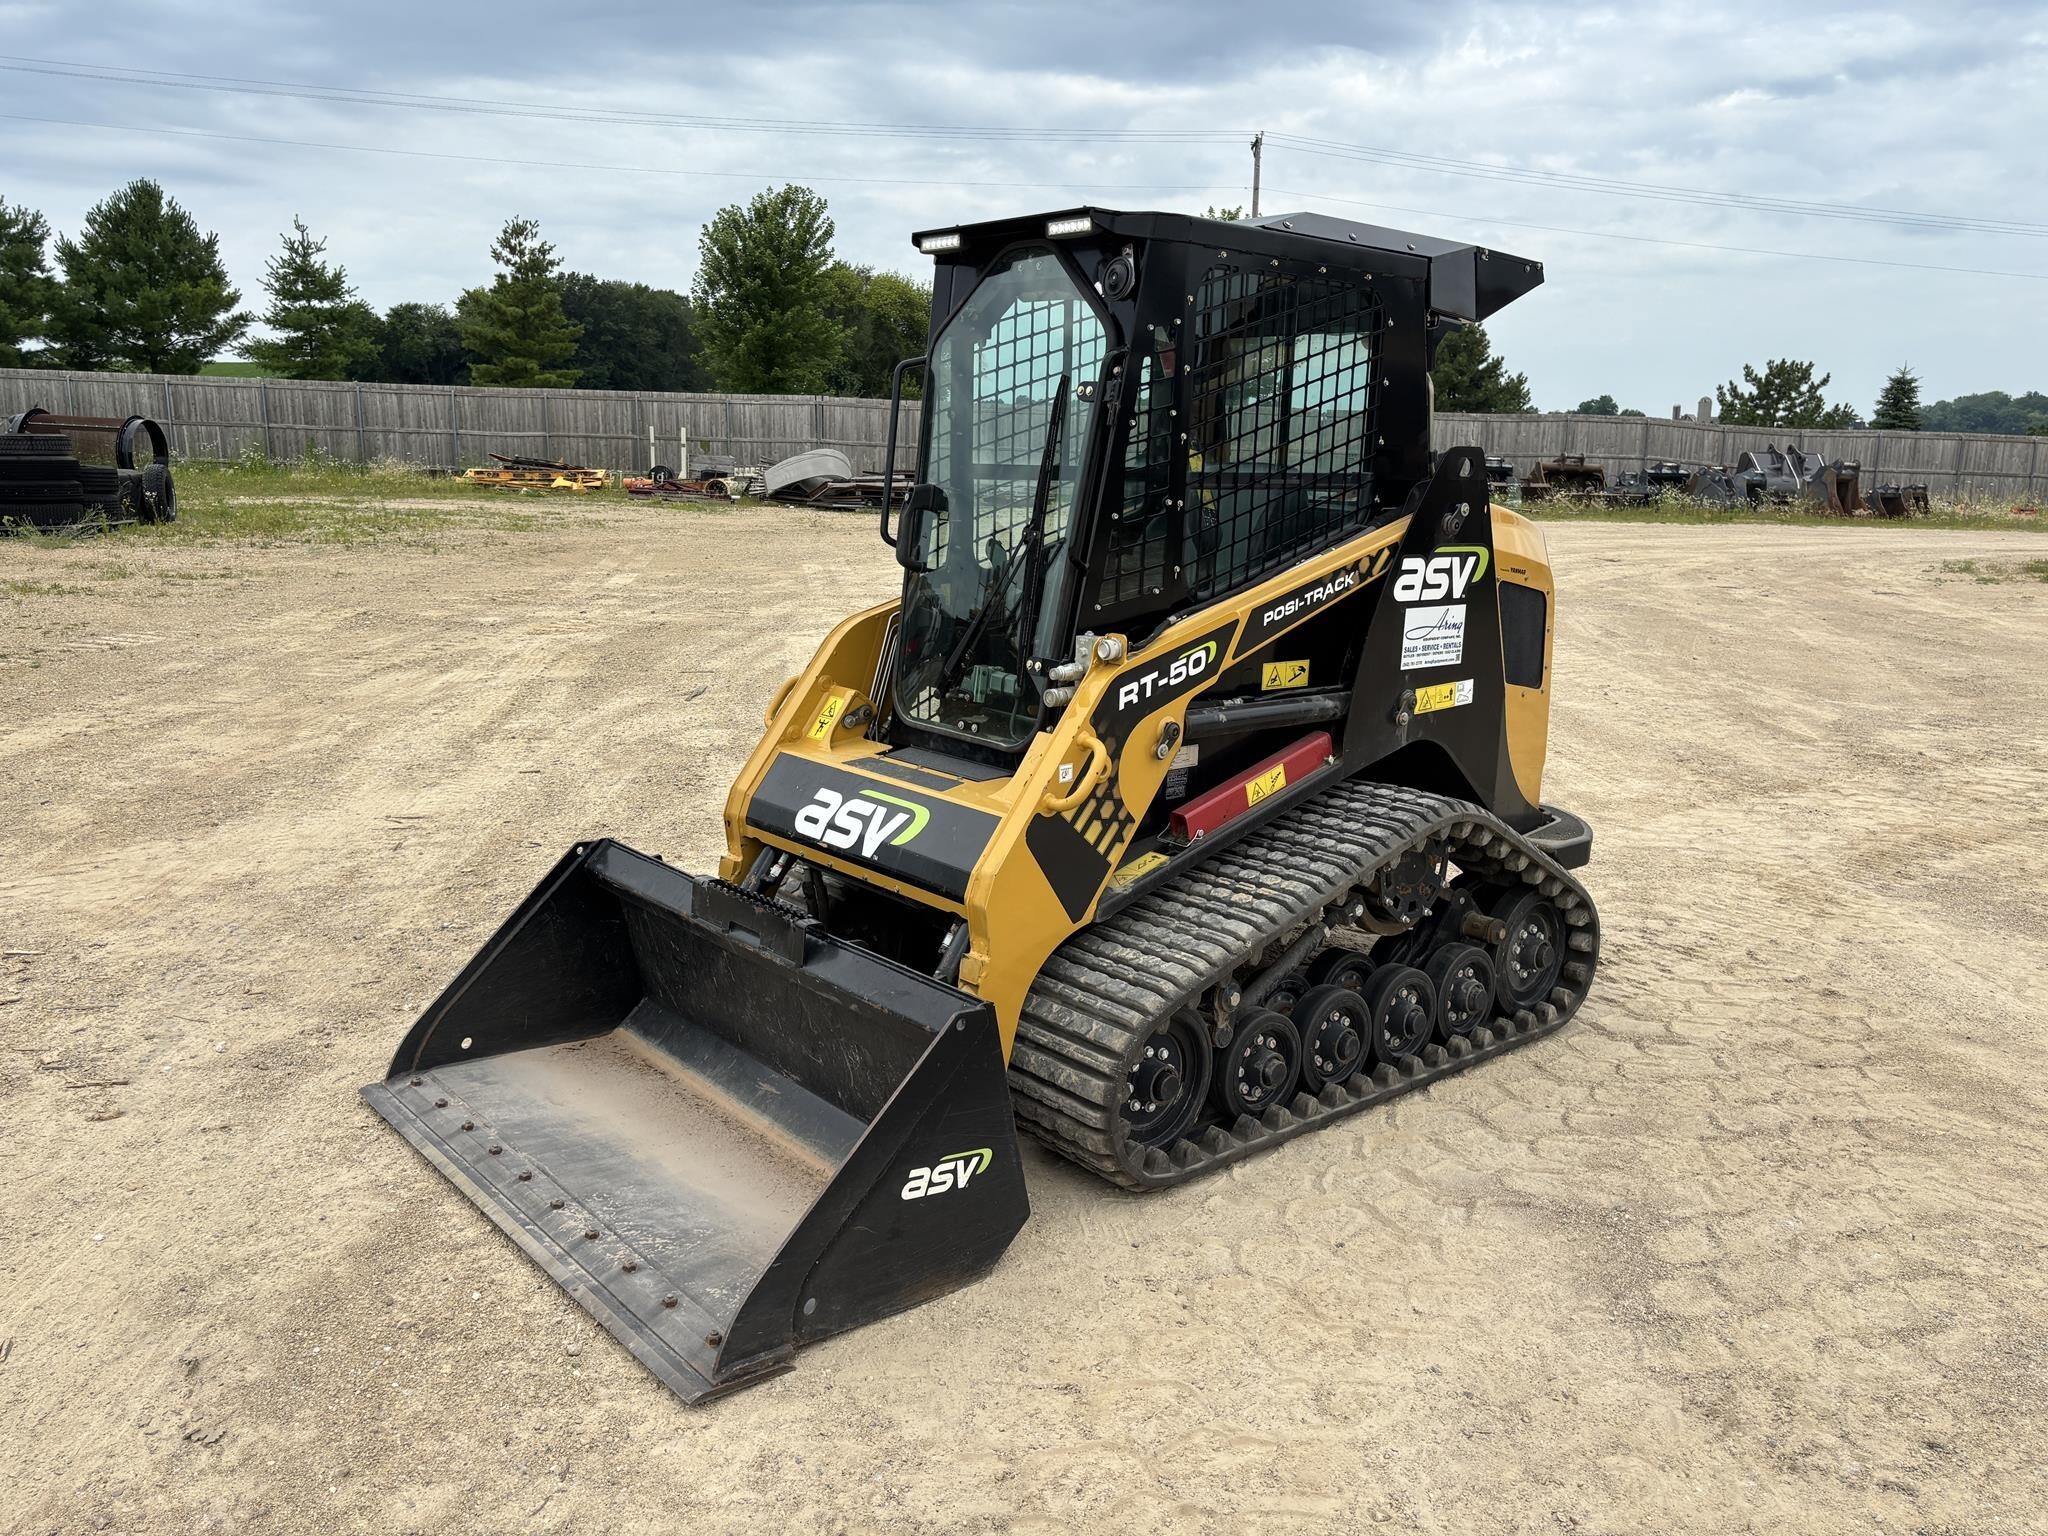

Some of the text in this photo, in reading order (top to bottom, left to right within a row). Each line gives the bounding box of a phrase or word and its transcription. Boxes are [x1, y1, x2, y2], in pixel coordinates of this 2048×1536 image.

[1263, 571, 1355, 627] POSI-TRACK
[1405, 607, 1463, 640] Aring
[1404, 645, 1418, 654] SALES
[1421, 643, 1440, 652] SERVICE
[1443, 641, 1462, 650] RENTALS
[1119, 649, 1207, 712] RT-50
